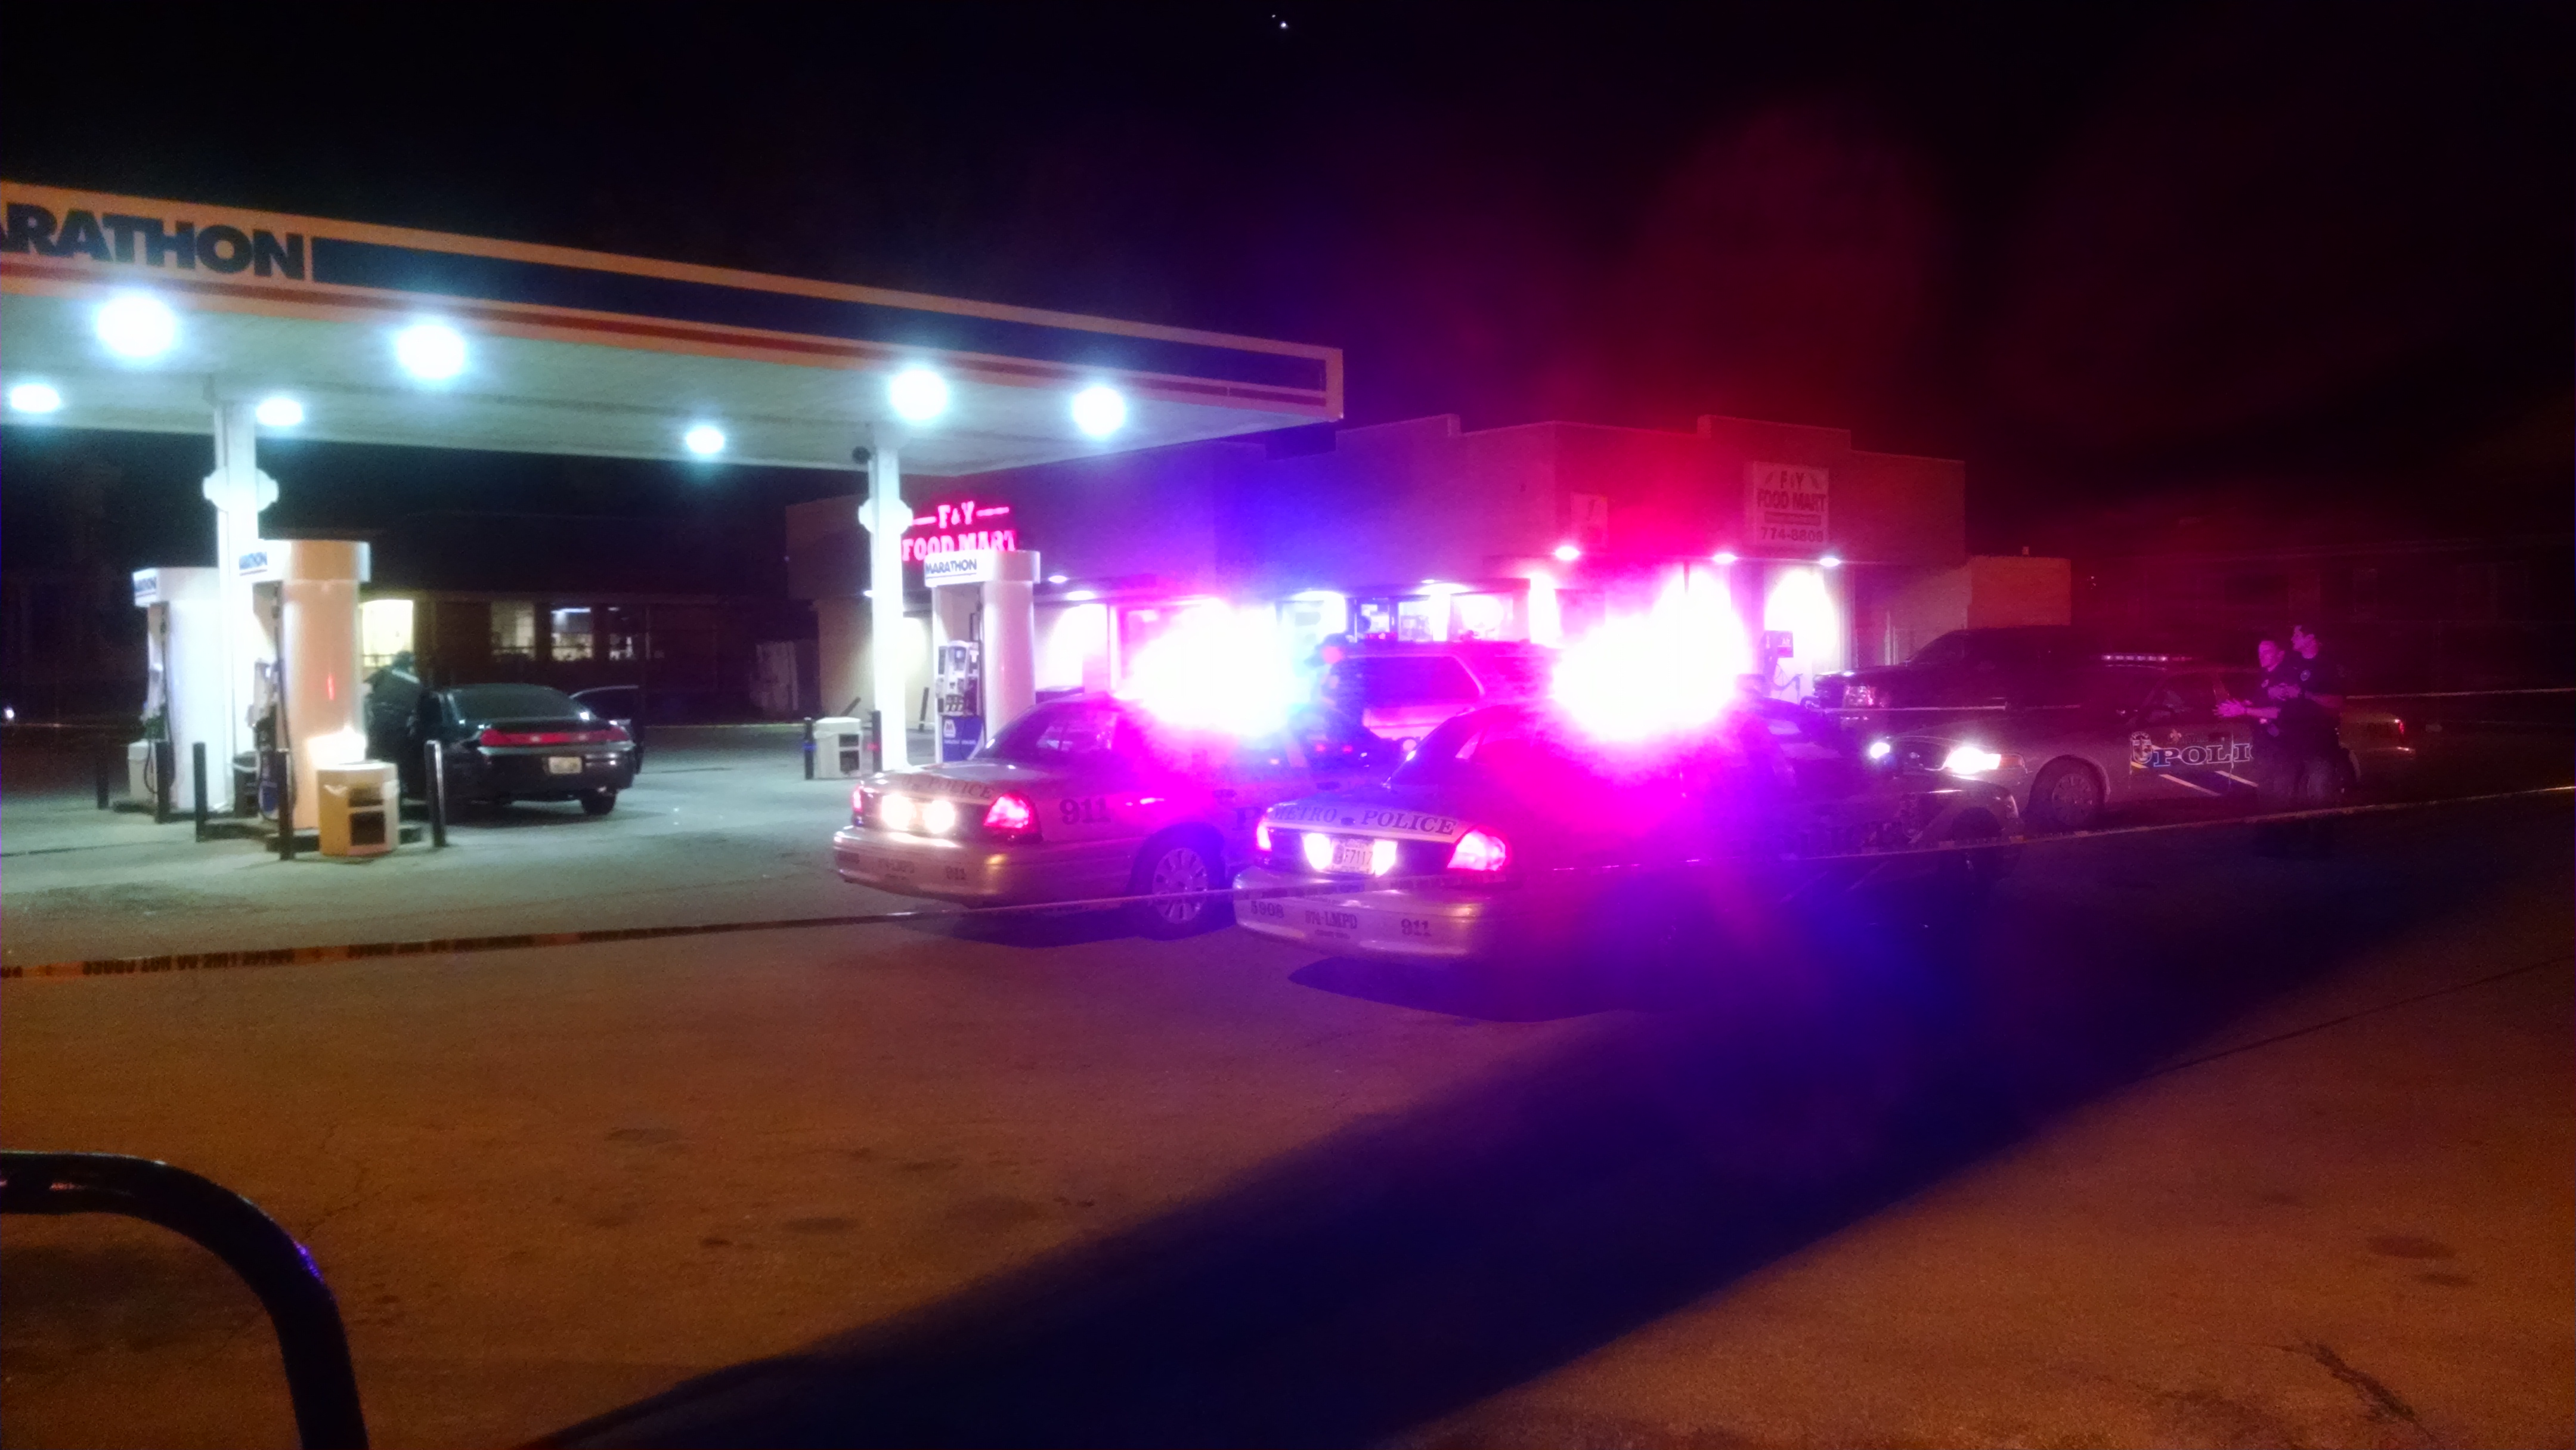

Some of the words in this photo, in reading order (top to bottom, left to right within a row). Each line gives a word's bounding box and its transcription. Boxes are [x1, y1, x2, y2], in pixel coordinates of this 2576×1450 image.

[0, 202, 305, 280] RATHON
[1757, 489, 1789, 509] FOOD
[1792, 492, 1826, 512] MART
[902, 535, 954, 561] FOOD
[958, 530, 1015, 552] MART
[925, 559, 977, 574] MARATHON
[2153, 743, 2254, 767] POLI
[1059, 798, 1111, 825] 911
[1272, 806, 1337, 823] METRO
[1361, 809, 1457, 836] POLICE
